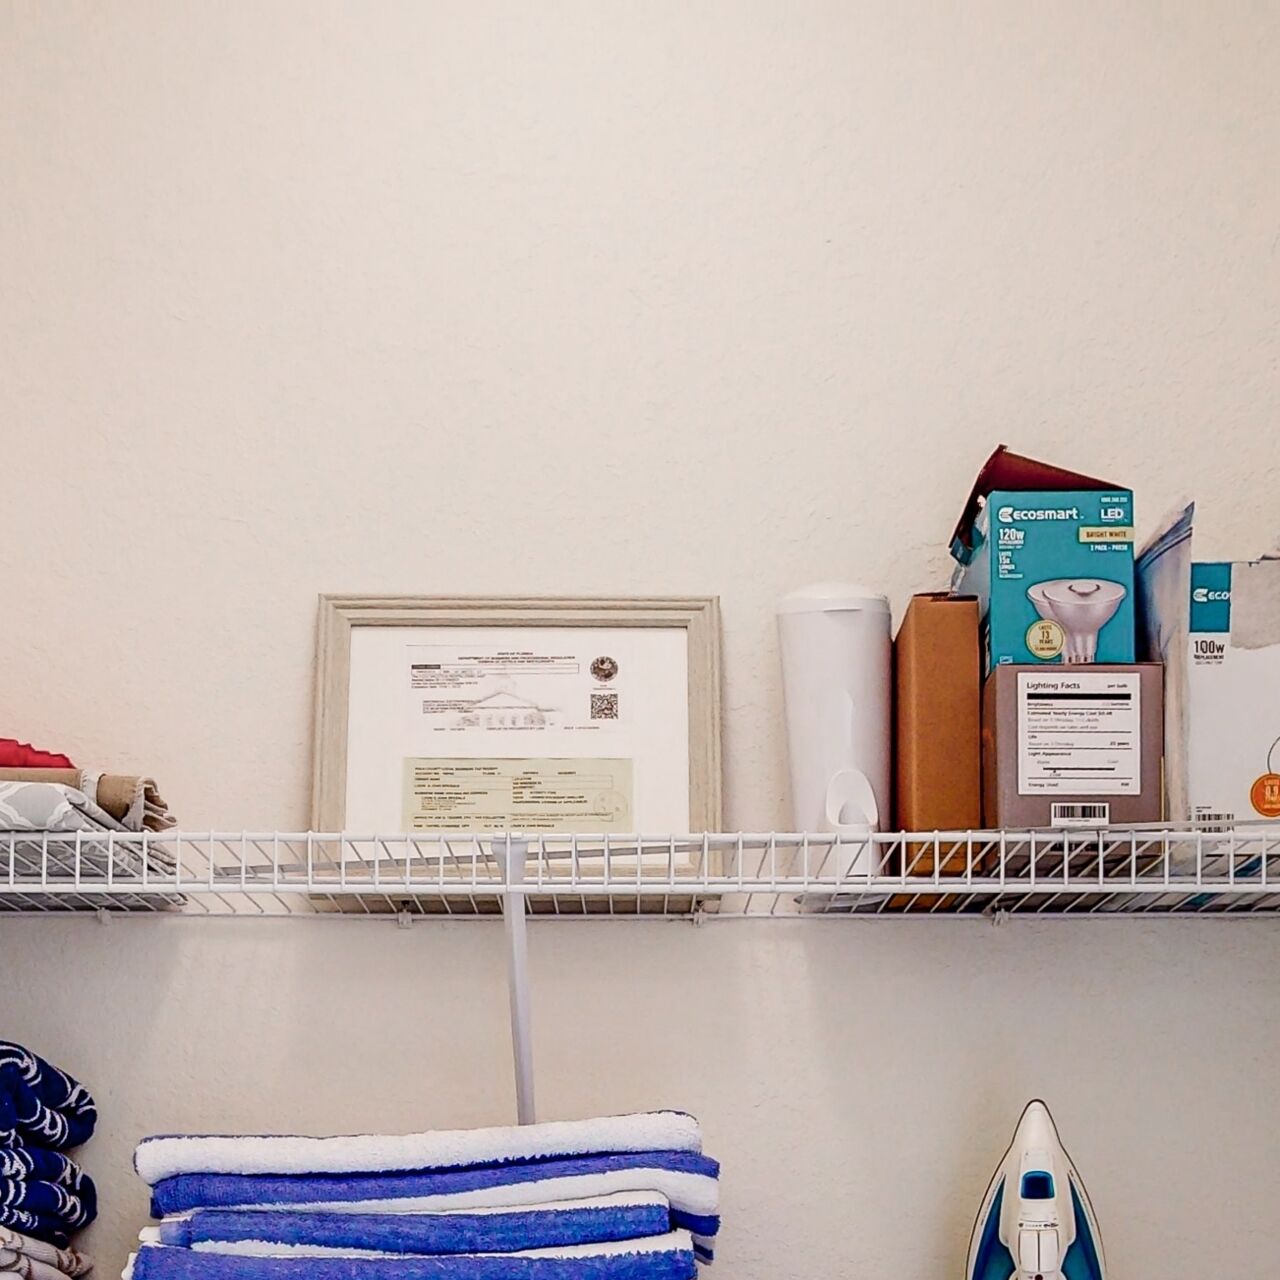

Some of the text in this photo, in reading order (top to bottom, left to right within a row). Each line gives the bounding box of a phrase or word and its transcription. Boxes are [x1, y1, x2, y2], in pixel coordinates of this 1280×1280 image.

[1013, 507, 1078, 520] ecosmart
[1101, 508, 1124, 519] LED
[1086, 531, 1127, 539] BRIGHT WHITE
[1208, 591, 1231, 600] eco
[1042, 631, 1050, 640] 13
[1194, 640, 1224, 653] 100w
[1027, 682, 1058, 691] Lighting
